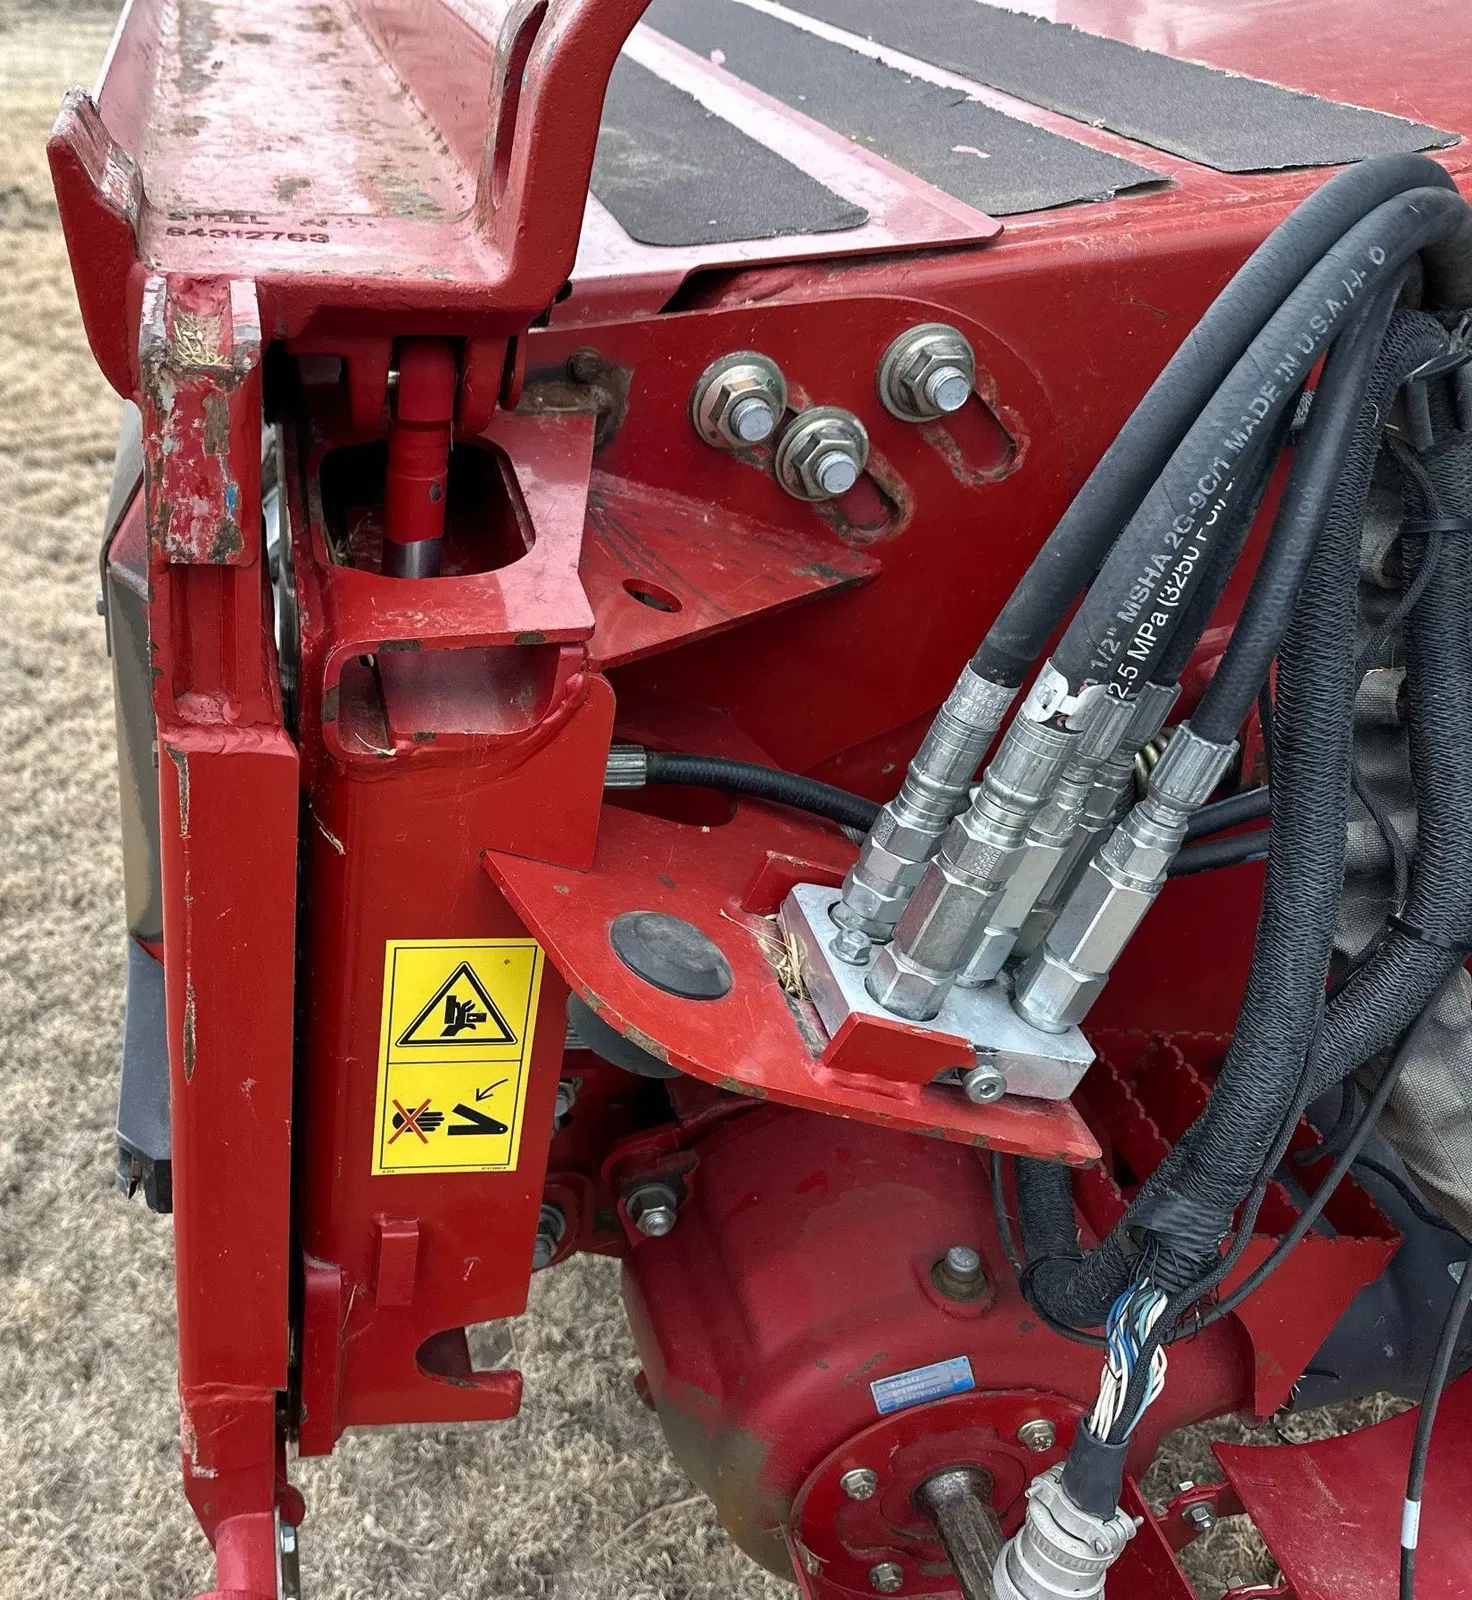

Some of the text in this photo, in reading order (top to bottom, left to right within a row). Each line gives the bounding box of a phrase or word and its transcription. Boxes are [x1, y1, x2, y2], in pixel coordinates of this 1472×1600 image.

[1116, 552, 1173, 623] MSHA
[1223, 380, 1283, 453] MADE
[1274, 352, 1301, 382] IN
[1293, 298, 1348, 354] U.S.A.
[1126, 610, 1169, 662] MPa
